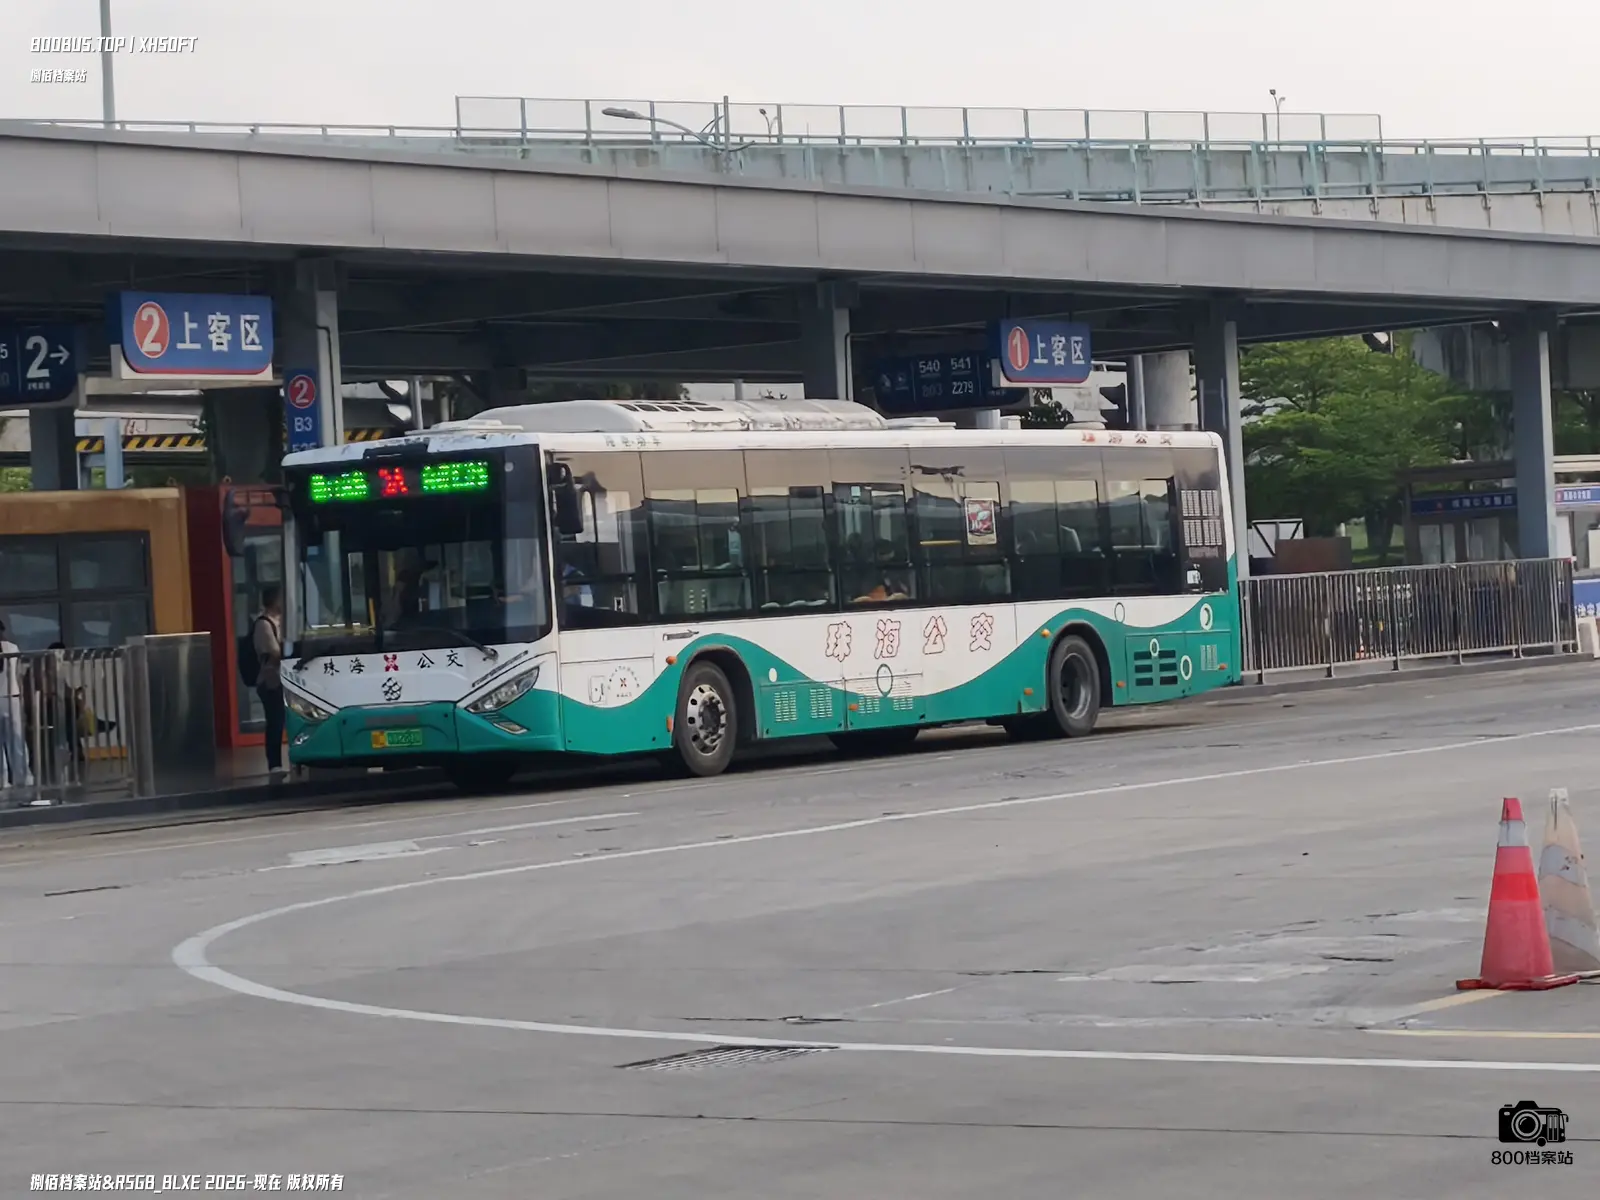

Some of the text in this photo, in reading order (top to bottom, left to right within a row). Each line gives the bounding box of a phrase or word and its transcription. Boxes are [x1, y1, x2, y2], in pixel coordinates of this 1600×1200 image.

[139, 307, 264, 353] 2 上客区
[25, 335, 50, 379] 2
[918, 356, 972, 374] 540 541
[1032, 333, 1086, 367] 上客区
[292, 377, 311, 405] 2
[294, 416, 313, 433] B3
[824, 612, 995, 663] 珠海公交
[323, 656, 366, 676] 珠海
[416, 650, 464, 670] 公交
